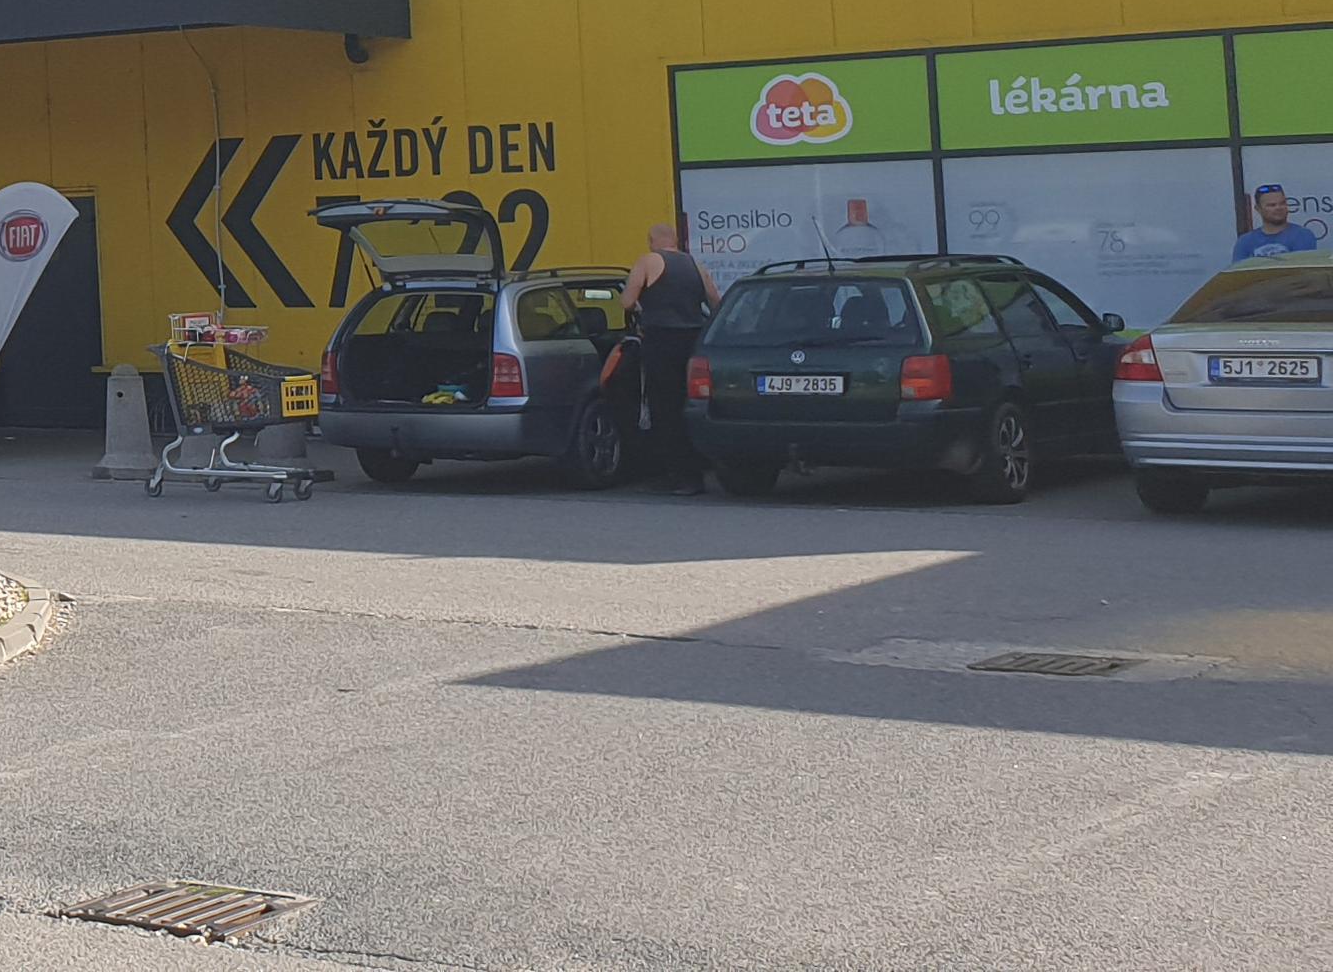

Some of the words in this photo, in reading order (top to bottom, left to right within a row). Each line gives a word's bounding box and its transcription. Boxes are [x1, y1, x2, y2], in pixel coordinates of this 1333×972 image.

[767, 98, 837, 130] teta
[989, 71, 1169, 117] lékárna
[312, 115, 448, 181] KAŽDÝ
[469, 121, 556, 175] DEN
[698, 208, 793, 231] Sensibio
[9, 224, 38, 249] FIAT
[700, 233, 747, 254] H2O
[1223, 360, 1253, 375] 5J1
[1267, 360, 1310, 376] 2625
[768, 377, 792, 391] 4J9
[804, 377, 837, 391] 2835
